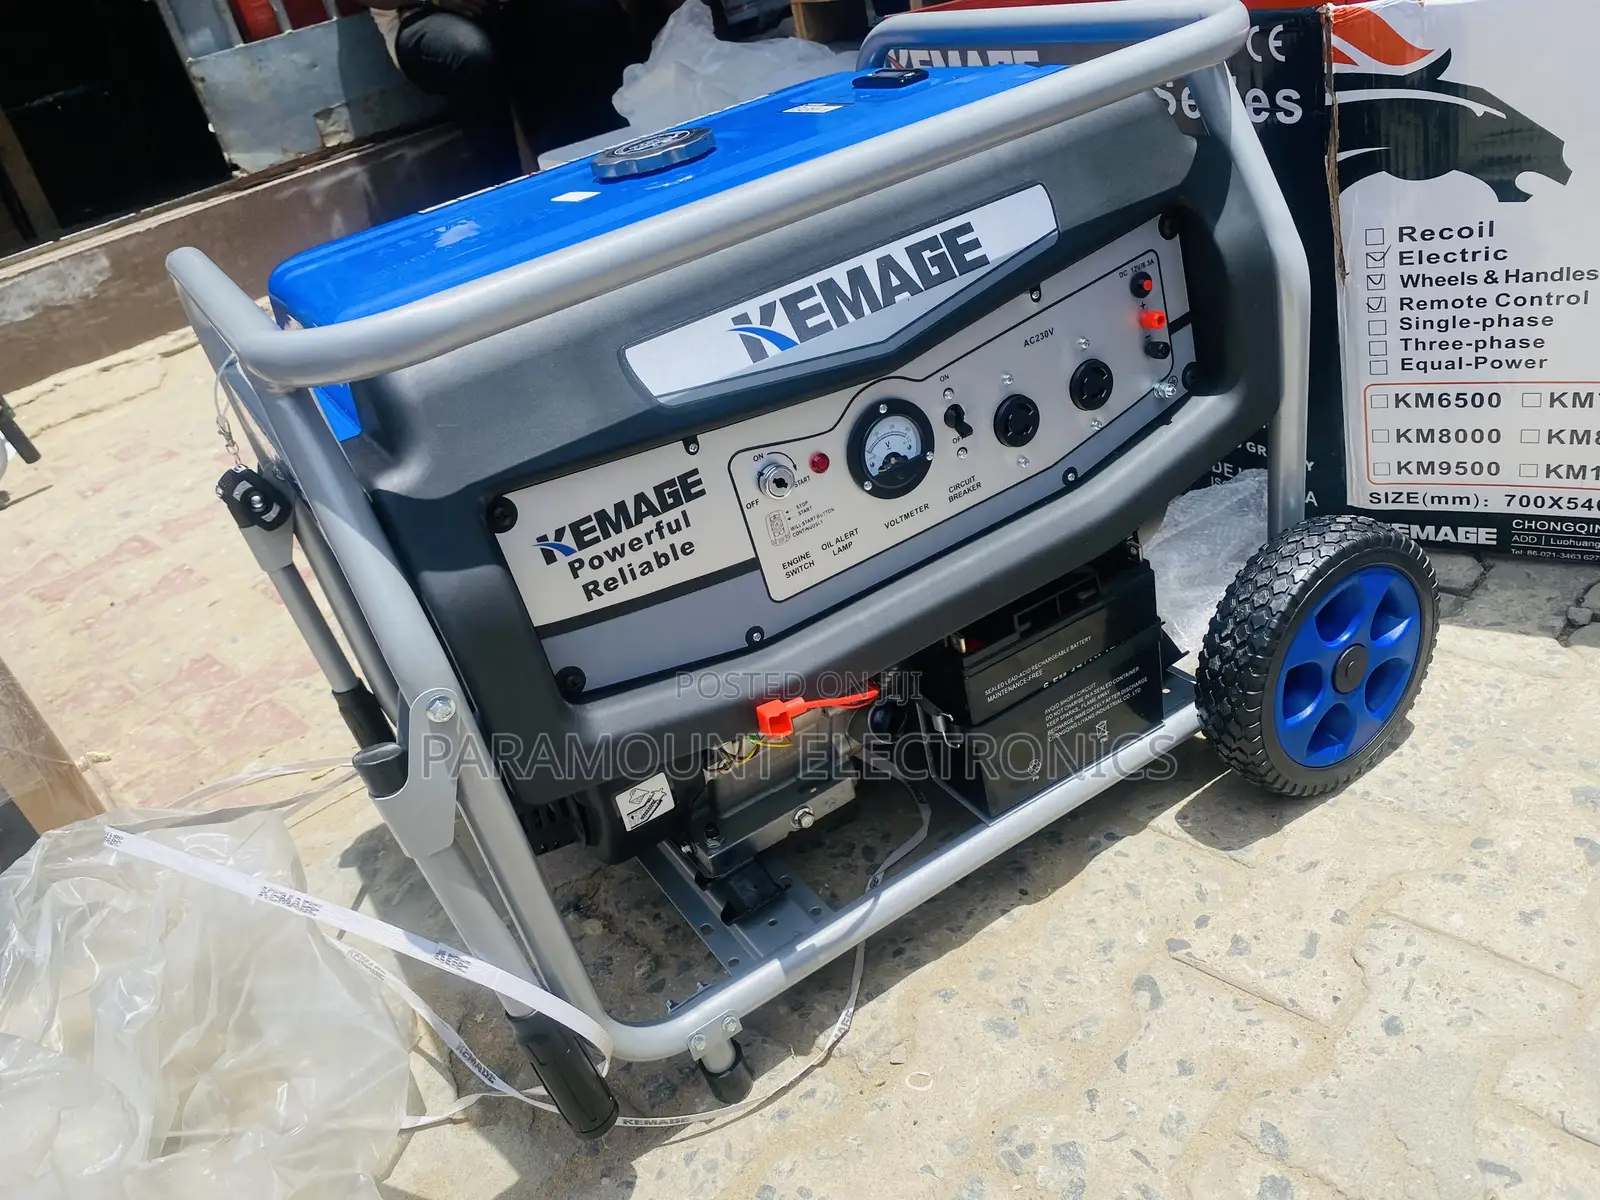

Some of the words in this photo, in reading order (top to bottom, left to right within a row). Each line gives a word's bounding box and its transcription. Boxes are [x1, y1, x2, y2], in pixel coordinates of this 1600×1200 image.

[1399, 220, 1494, 243] Recoil
[1399, 246, 1508, 266] Electric
[1118, 269, 1128, 278] DC
[1400, 271, 1478, 288] Wheels
[1484, 269, 1499, 285] &
[1505, 267, 1599, 284] Handles
[727, 221, 990, 364] KEMAGE
[1400, 295, 1487, 311] Remote
[1496, 290, 1589, 307] Control
[1399, 314, 1554, 333] Single-phase
[1023, 327, 1055, 348] AC230V
[1400, 335, 1545, 352] Three-phase
[1401, 356, 1548, 373] Equal-Power
[939, 374, 950, 382] ON
[1394, 392, 1502, 408] KM6500
[1549, 392, 1600, 408] KM
[1396, 428, 1502, 443] KM8000
[753, 453, 764, 462] ON
[1397, 461, 1501, 476] KM9500
[794, 475, 811, 487] START
[948, 475, 976, 493] CIRCUIT
[948, 481, 982, 503] BREAKER
[745, 499, 760, 510] OFF
[533, 468, 707, 566] KEMAGE
[884, 503, 930, 529] VOLTMETER
[821, 541, 834, 551] OIL
[835, 528, 860, 545] ALERT
[1387, 523, 1498, 545] EMAGE
[1512, 535, 1537, 543] ADD
[567, 509, 692, 580] Powerful
[833, 541, 853, 556] LAMP
[782, 551, 811, 570] ENGINE
[785, 560, 815, 579] SWITCH
[582, 541, 695, 602] Reliable
[984, 682, 1005, 696] SEALED
[1005, 667, 1031, 686] LEAD-ACID
[1031, 647, 1070, 671] RECHARGEABLE
[1070, 635, 1092, 651] BATTERY
[987, 669, 1044, 703] MAINTENANCE-FREE
[1060, 694, 1077, 706] SHORT
[1077, 682, 1096, 697] CIRCUIT
[1064, 698, 1084, 711] CHARGE
[1094, 681, 1113, 695] SEALED
[1112, 666, 1140, 685] CONTAINER
